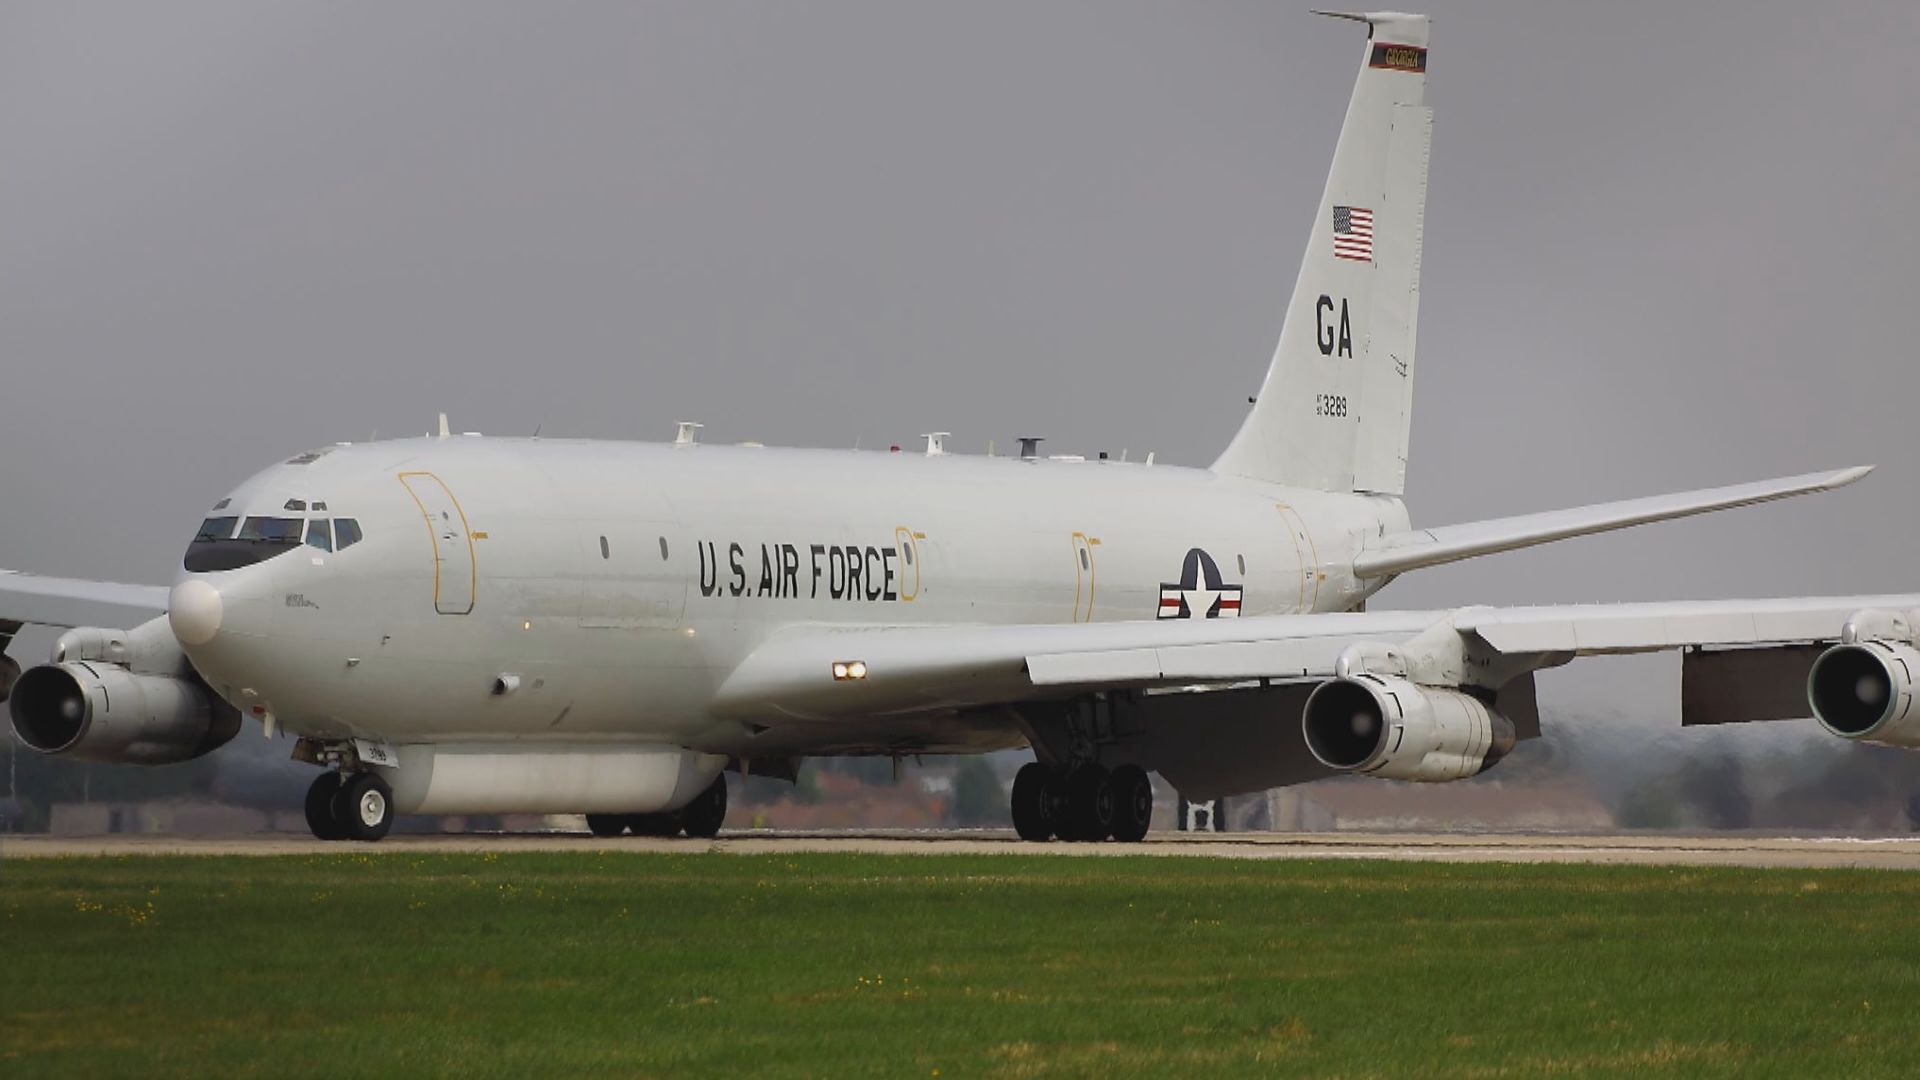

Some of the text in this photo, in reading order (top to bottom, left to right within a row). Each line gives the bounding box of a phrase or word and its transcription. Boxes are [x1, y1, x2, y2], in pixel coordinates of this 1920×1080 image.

[1316, 294, 1352, 359] GA
[1323, 394, 1347, 417] 3289
[759, 543, 798, 598] AIR
[810, 544, 897, 601] FORCE
